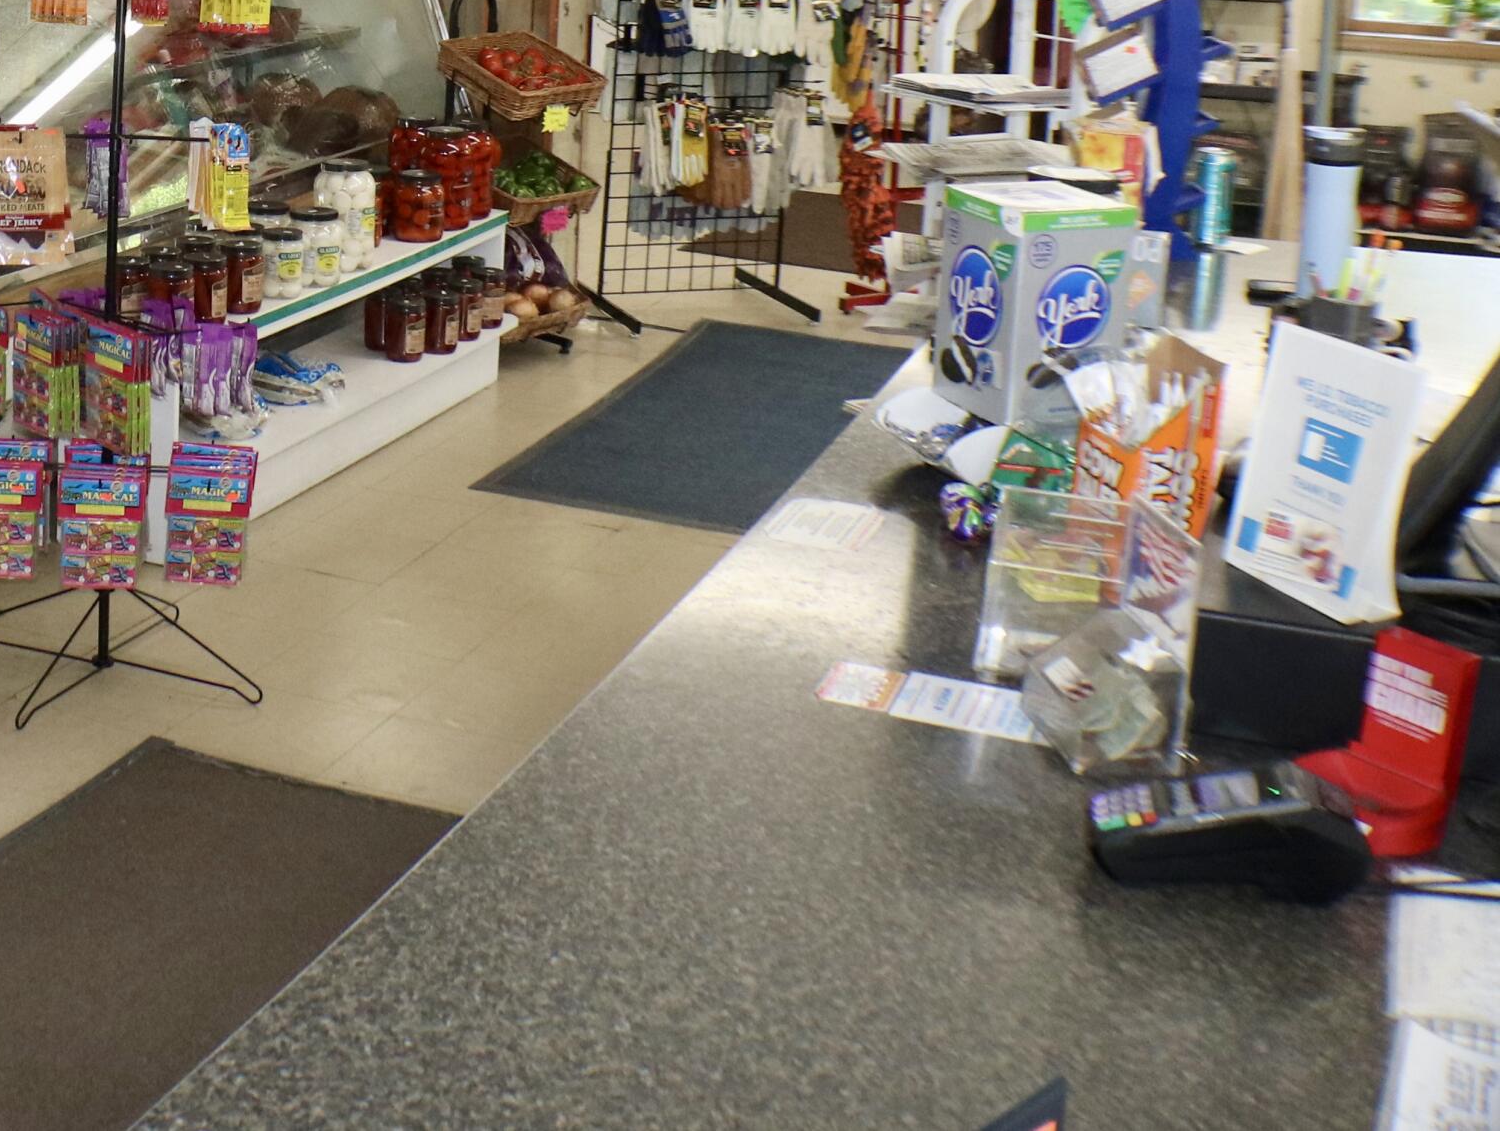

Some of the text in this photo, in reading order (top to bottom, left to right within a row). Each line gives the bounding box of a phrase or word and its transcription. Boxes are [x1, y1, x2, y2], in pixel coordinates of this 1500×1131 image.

[13, 218, 43, 228] JERKY
[950, 269, 997, 335] York
[1038, 279, 1103, 345] York
[98, 340, 132, 360] MAGICAL
[82, 491, 136, 503] MACAL
